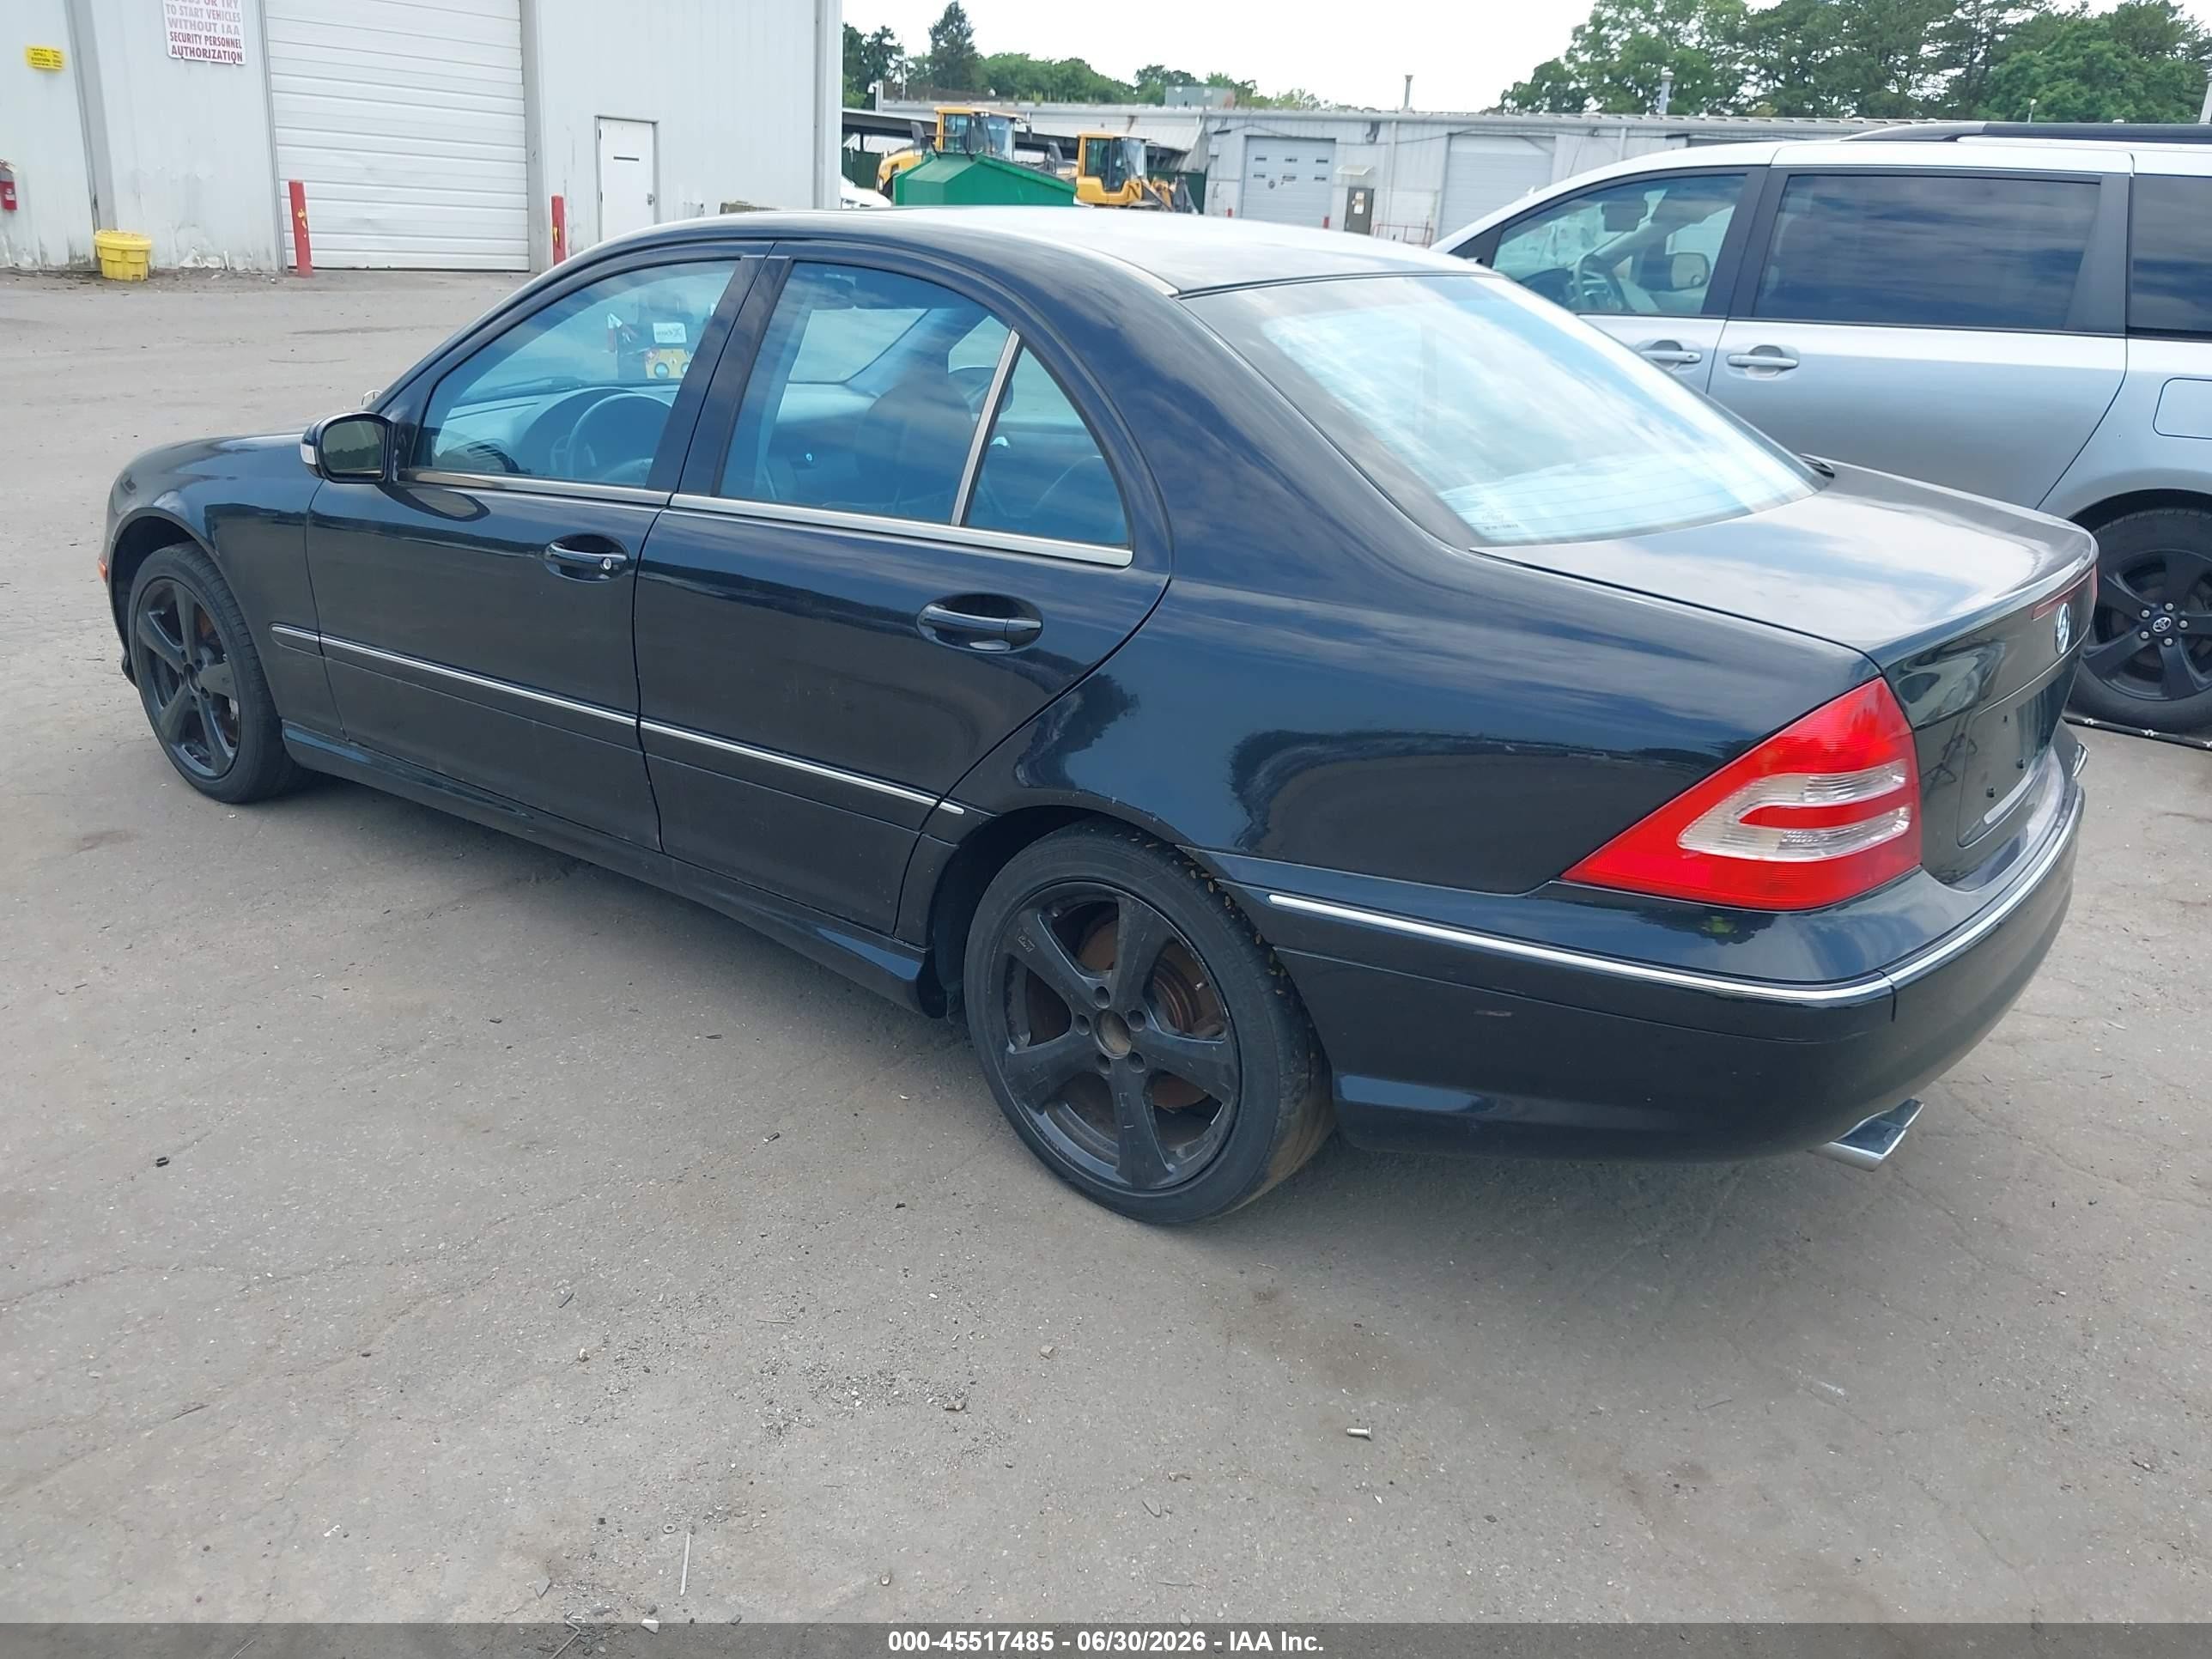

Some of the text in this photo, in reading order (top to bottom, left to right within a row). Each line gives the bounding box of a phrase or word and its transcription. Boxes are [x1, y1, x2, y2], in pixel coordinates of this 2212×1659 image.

[165, 3, 240, 22] TO START VEHICLES
[167, 17, 217, 33] WITHOUT
[169, 31, 242, 49] SECURITY PERSONNEL
[171, 45, 243, 62] AUTHORIZATION
